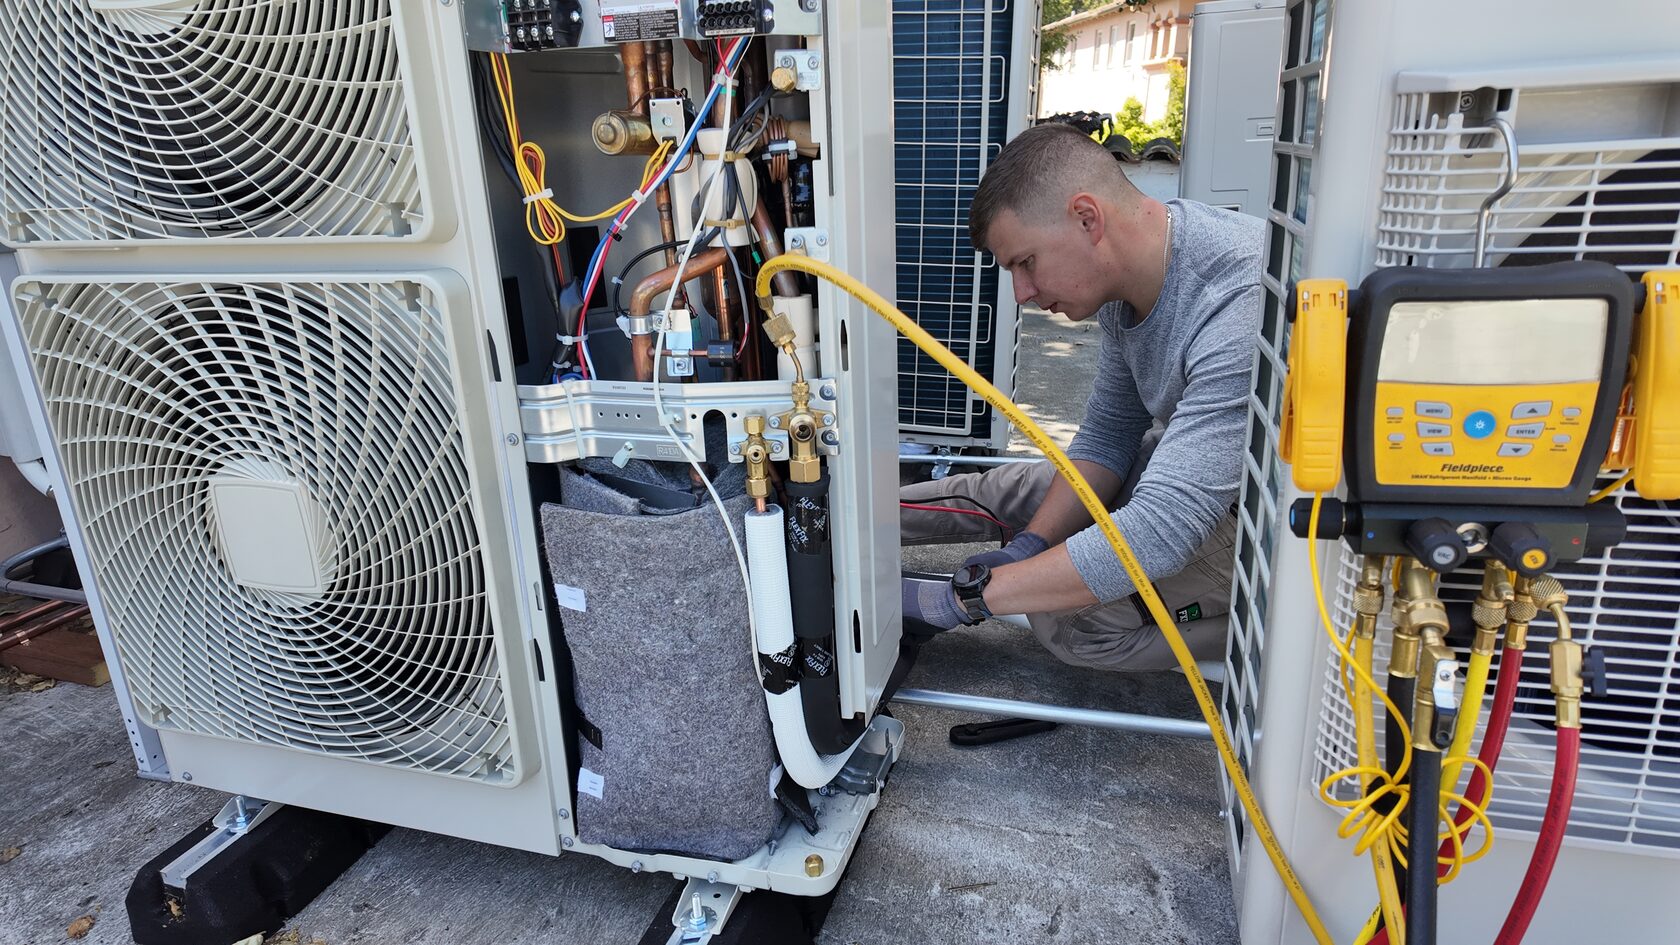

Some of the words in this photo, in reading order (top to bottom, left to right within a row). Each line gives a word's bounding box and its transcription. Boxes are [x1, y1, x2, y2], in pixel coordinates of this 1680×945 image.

[986, 393, 1007, 413] YELLOW
[1046, 450, 1067, 472] Charging
[1440, 464, 1504, 473] Fieldpiece
[789, 515, 809, 544] FLEXFIX
[805, 655, 828, 677] FLEXFIX
